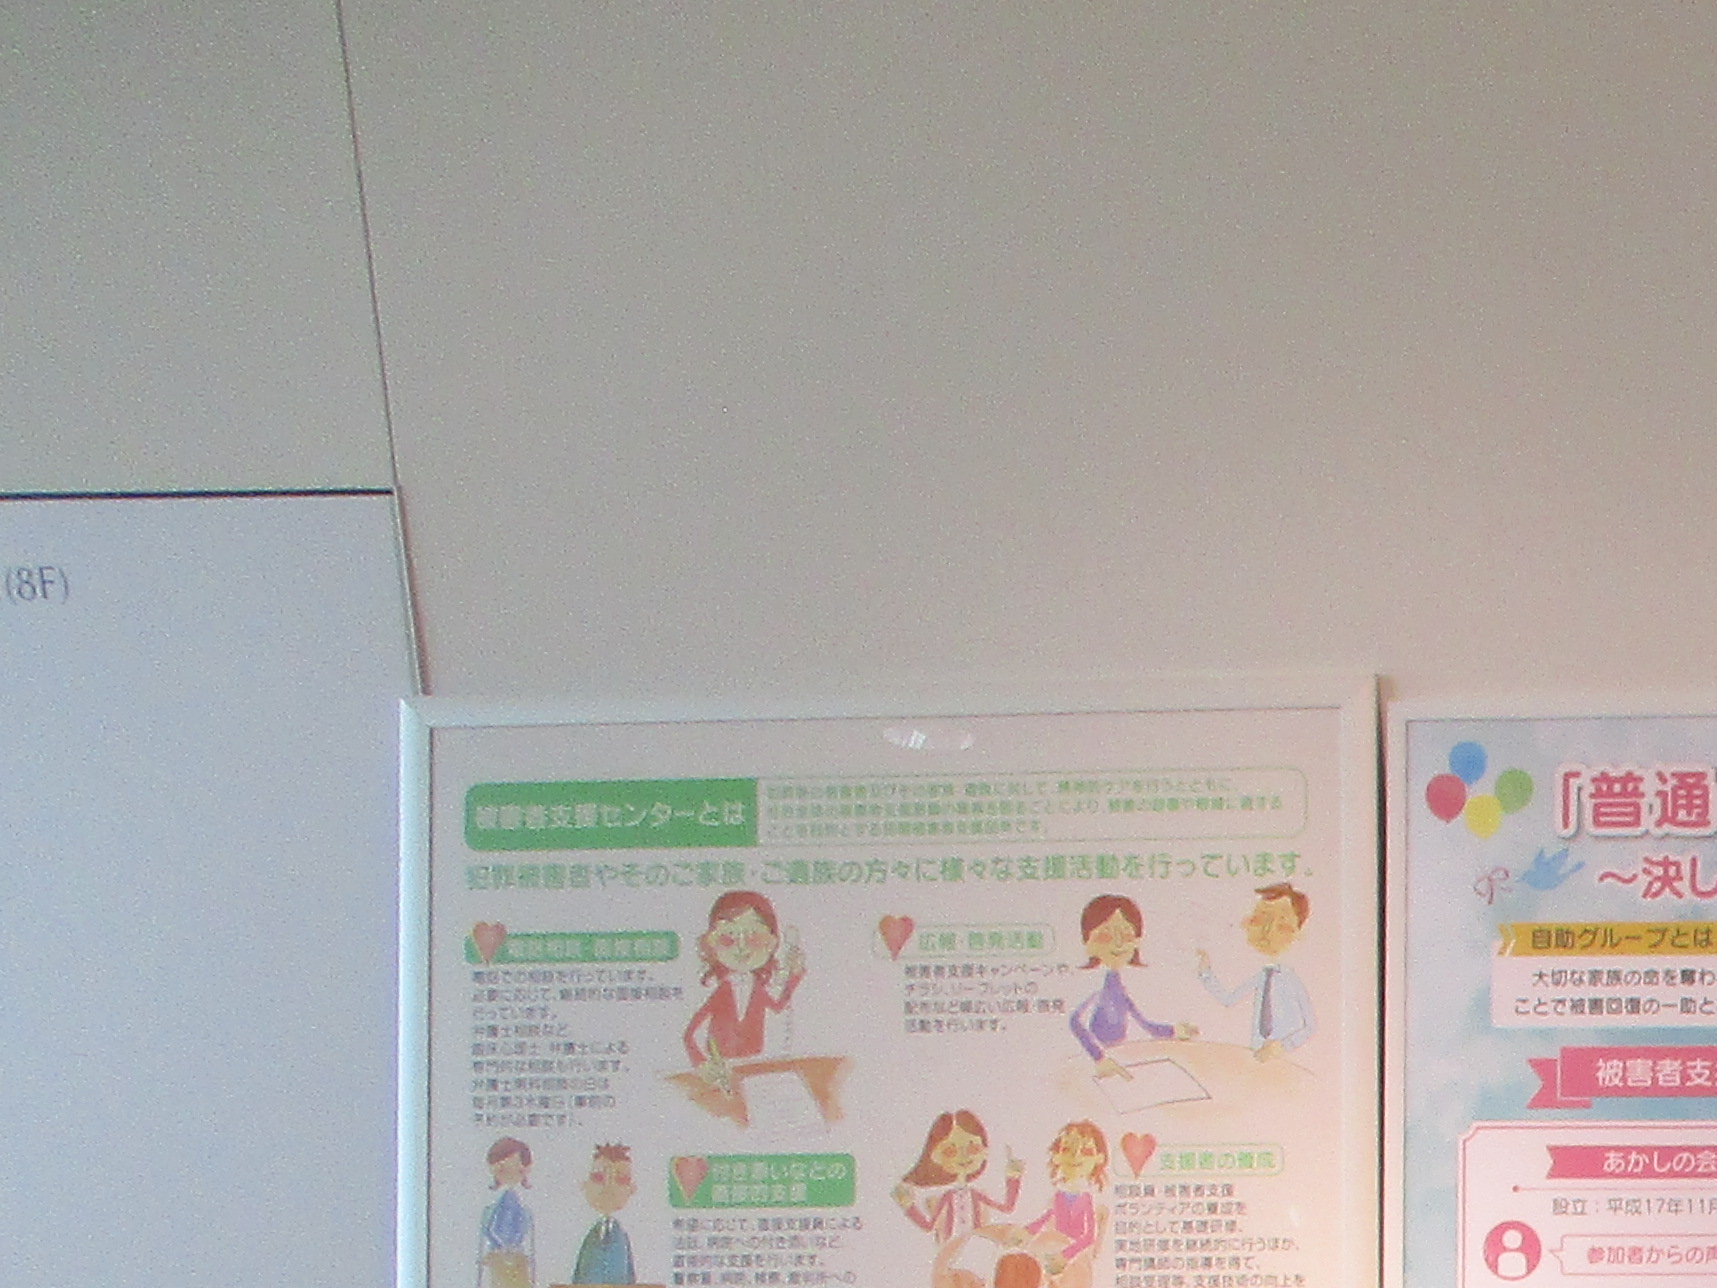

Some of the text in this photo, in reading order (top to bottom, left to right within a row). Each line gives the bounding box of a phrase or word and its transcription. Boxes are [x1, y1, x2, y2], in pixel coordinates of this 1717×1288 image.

[6, 565, 69, 606] (8F)
[476, 800, 744, 830] 被害者支援センターとは
[1530, 926, 1714, 951] 自助グループとは
